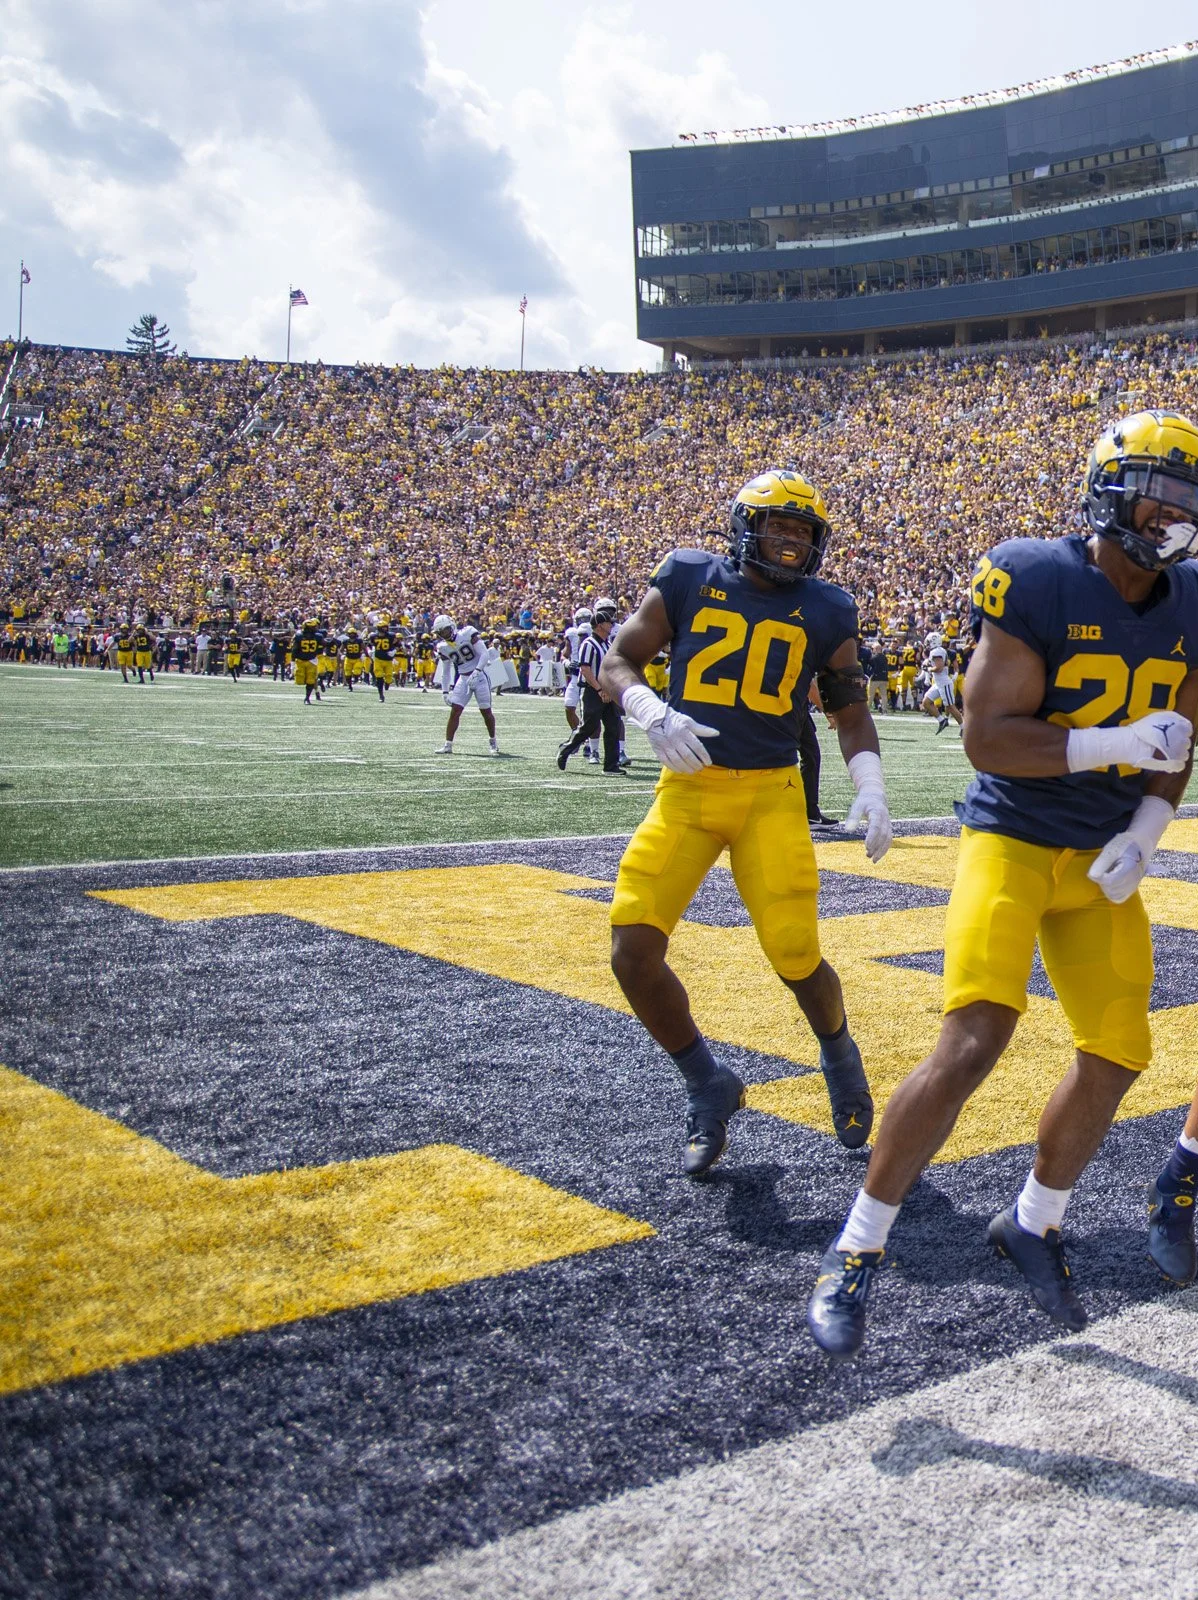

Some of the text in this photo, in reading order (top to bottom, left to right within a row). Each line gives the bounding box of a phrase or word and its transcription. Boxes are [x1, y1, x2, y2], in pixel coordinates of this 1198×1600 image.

[971, 556, 1012, 618] 28
[136, 637, 147, 646] 13
[301, 640, 318, 652] 53
[374, 639, 390, 650] 76
[347, 644, 360, 653] 58
[451, 644, 475, 665] 29
[903, 649, 916, 661] 72
[683, 607, 808, 717] 20
[534, 666, 543, 682] Z
